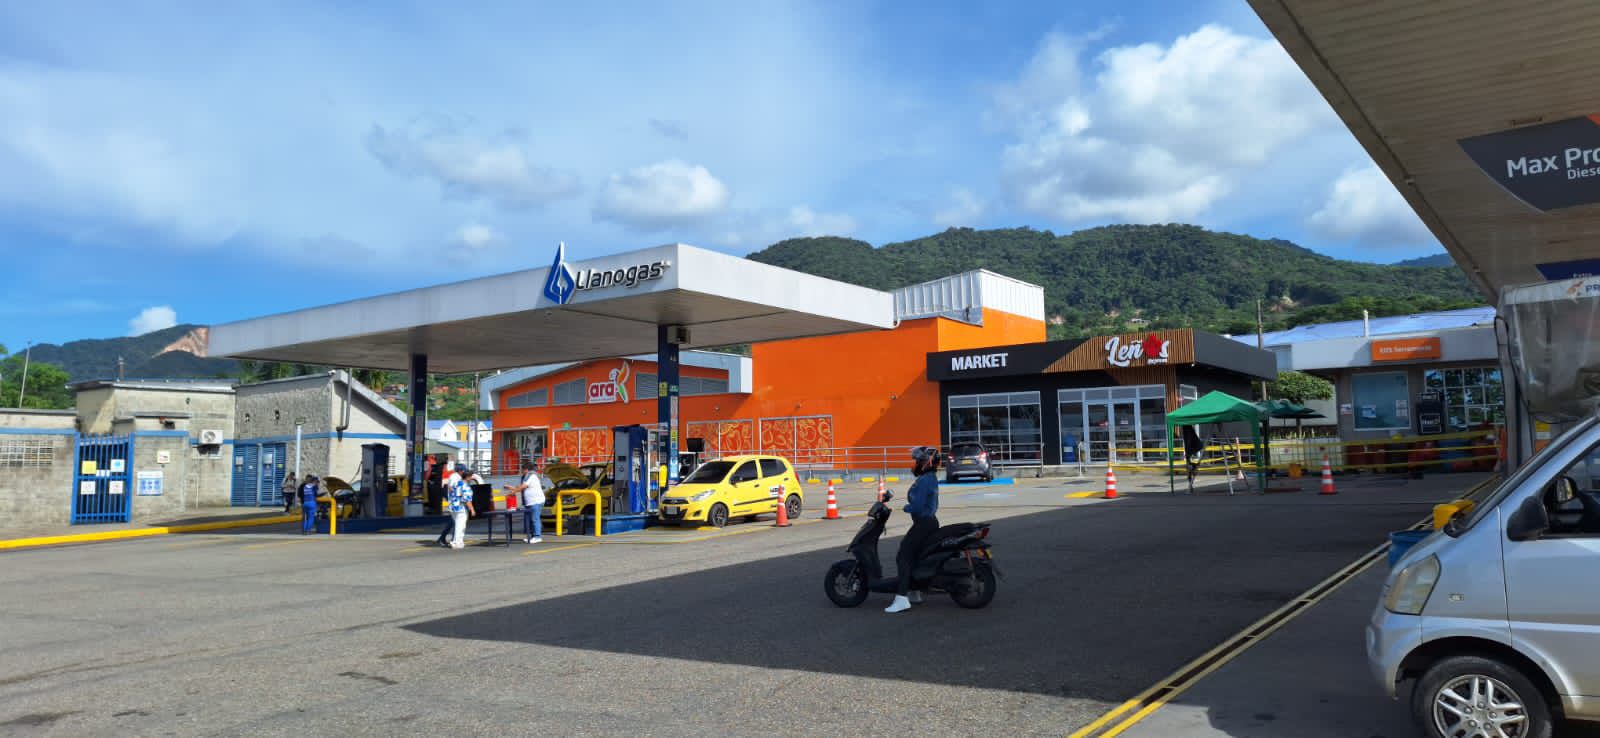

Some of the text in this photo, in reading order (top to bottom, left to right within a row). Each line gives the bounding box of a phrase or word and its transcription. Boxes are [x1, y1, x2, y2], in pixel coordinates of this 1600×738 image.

[1506, 156, 1559, 178] Max
[576, 261, 663, 289] Llanogas
[951, 352, 1008, 370] MARKET
[590, 384, 615, 397] ara
